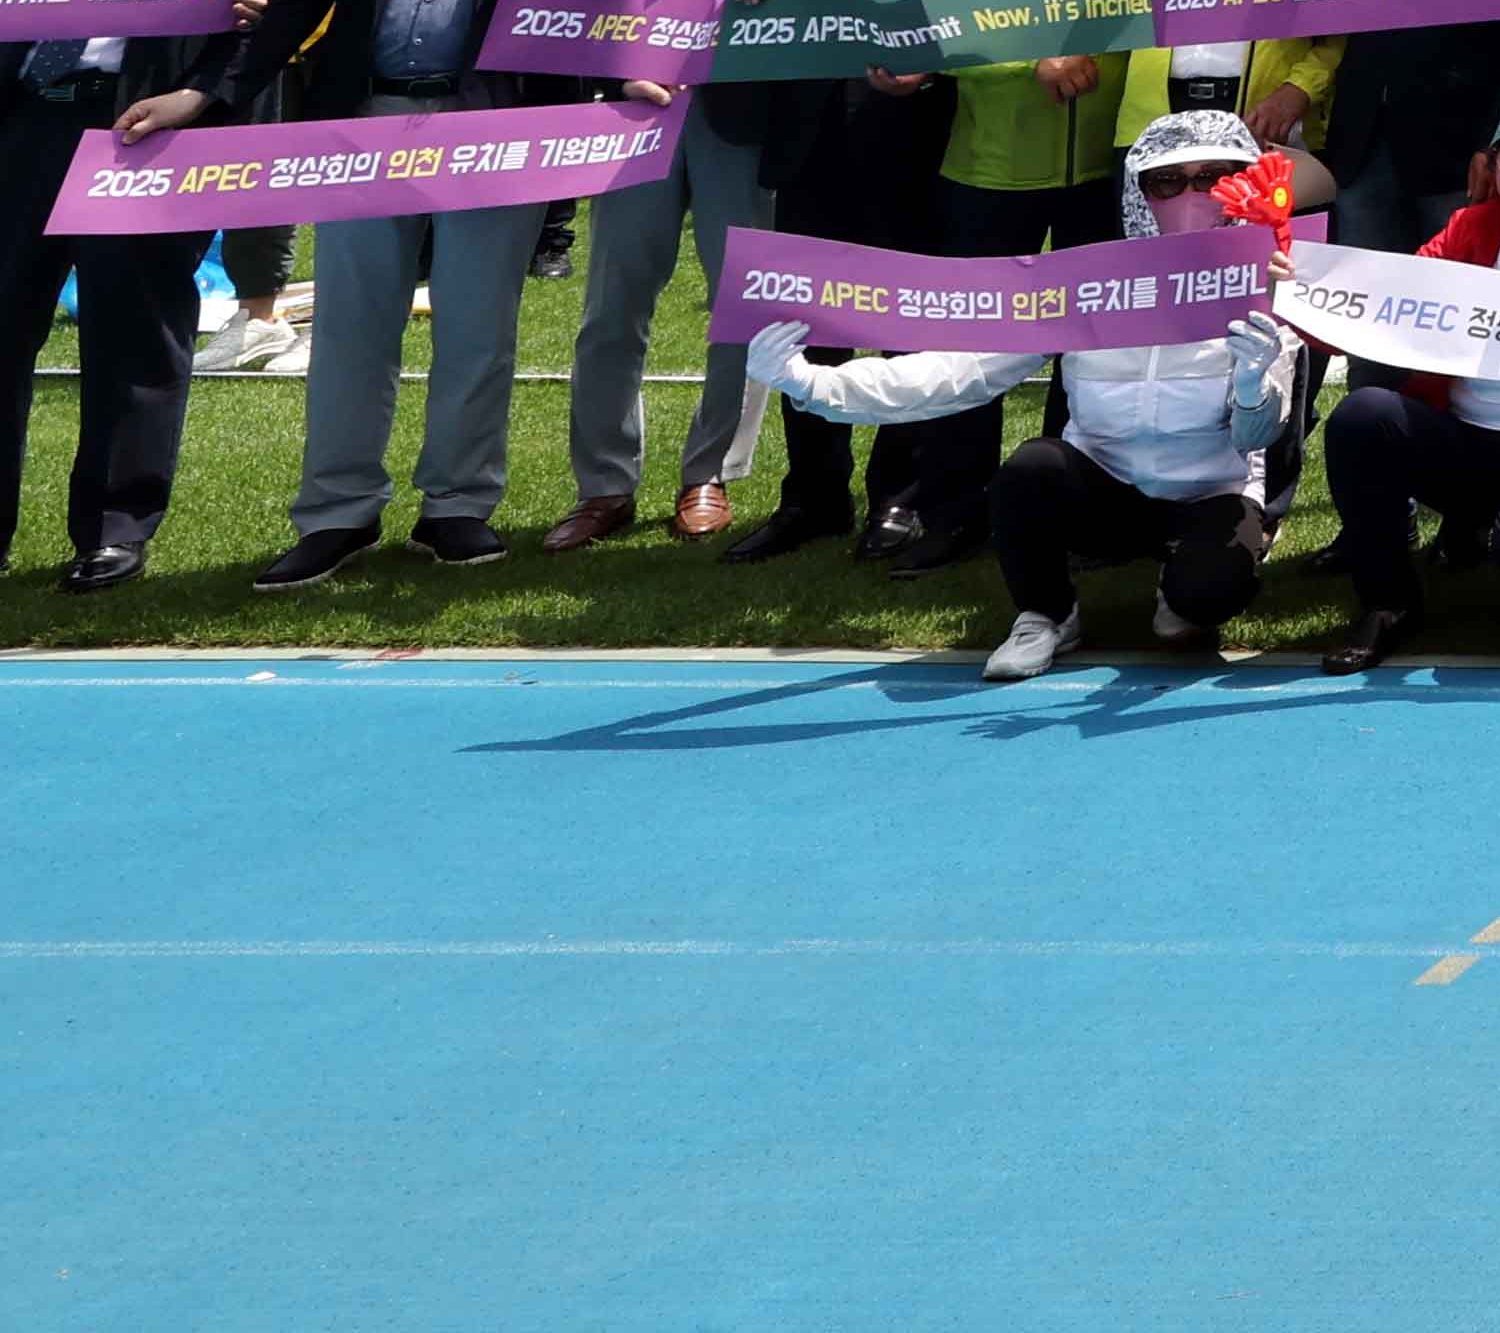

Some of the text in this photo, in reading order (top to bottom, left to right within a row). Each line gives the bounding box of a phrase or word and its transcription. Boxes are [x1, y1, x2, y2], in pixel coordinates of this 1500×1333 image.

[511, 8, 646, 42] 2025 APEC
[729, 17, 795, 45] 2025
[802, 16, 868, 45] APEC
[870, 15, 963, 49] Summit
[973, 3, 1039, 33] Now,
[87, 127, 662, 198] 2025 APEC 정상회의 인천 유치를 기원합니다.
[742, 270, 1158, 321] 2025 APEC 정상회의 인천 유치를
[1293, 282, 1368, 320] 2025
[1373, 295, 1459, 333] APEC
